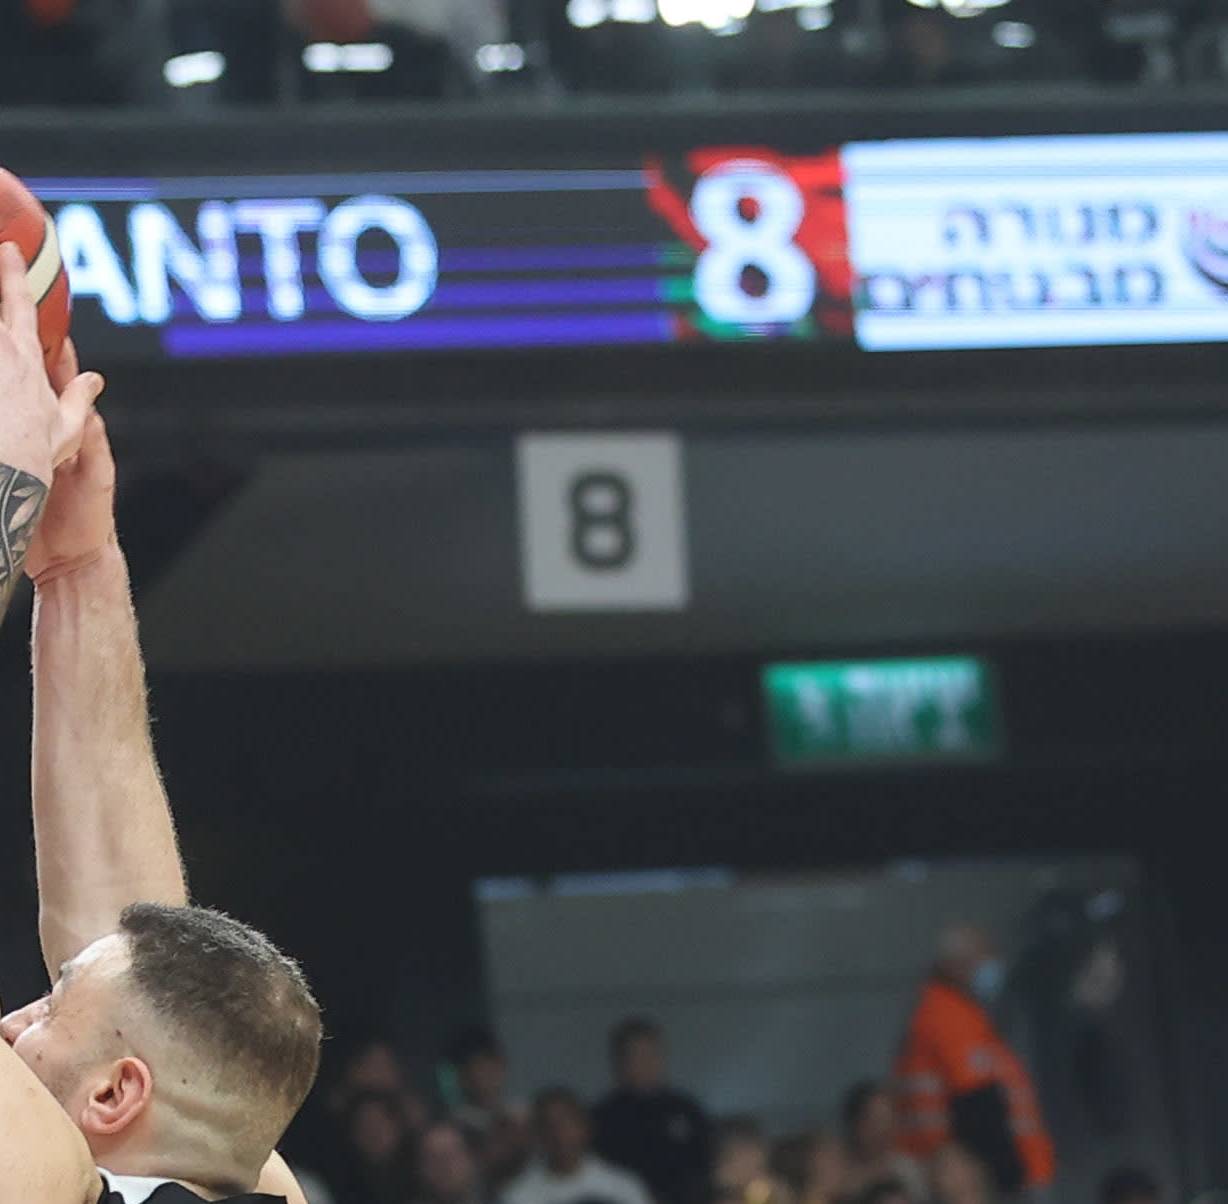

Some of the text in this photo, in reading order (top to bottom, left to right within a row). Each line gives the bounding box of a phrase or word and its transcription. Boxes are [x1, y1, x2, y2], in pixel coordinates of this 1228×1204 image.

[56, 194, 439, 324] ANTO
[688, 158, 817, 325] 8
[568, 467, 637, 571] 8
